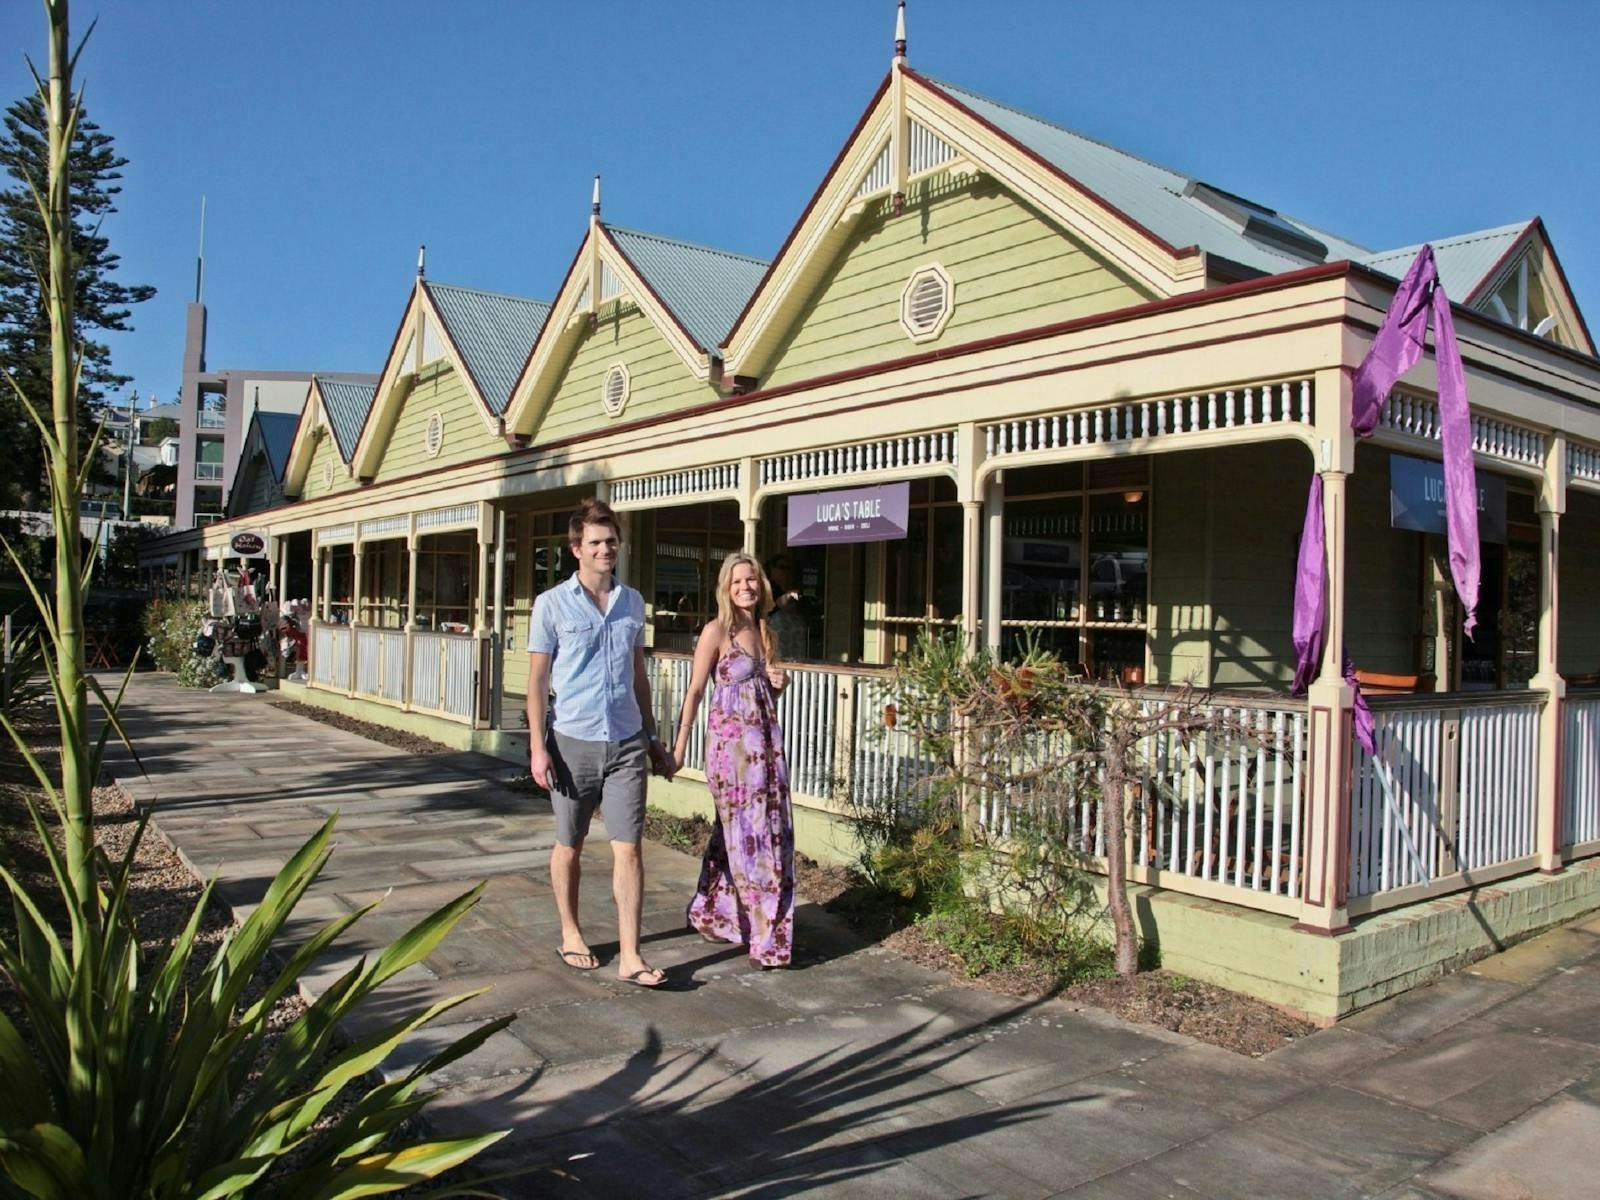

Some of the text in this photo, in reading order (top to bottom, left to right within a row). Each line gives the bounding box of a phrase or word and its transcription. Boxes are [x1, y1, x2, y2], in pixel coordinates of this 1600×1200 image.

[1424, 476, 1447, 504] LUC
[816, 499, 881, 523] LUCA'S TABLE
